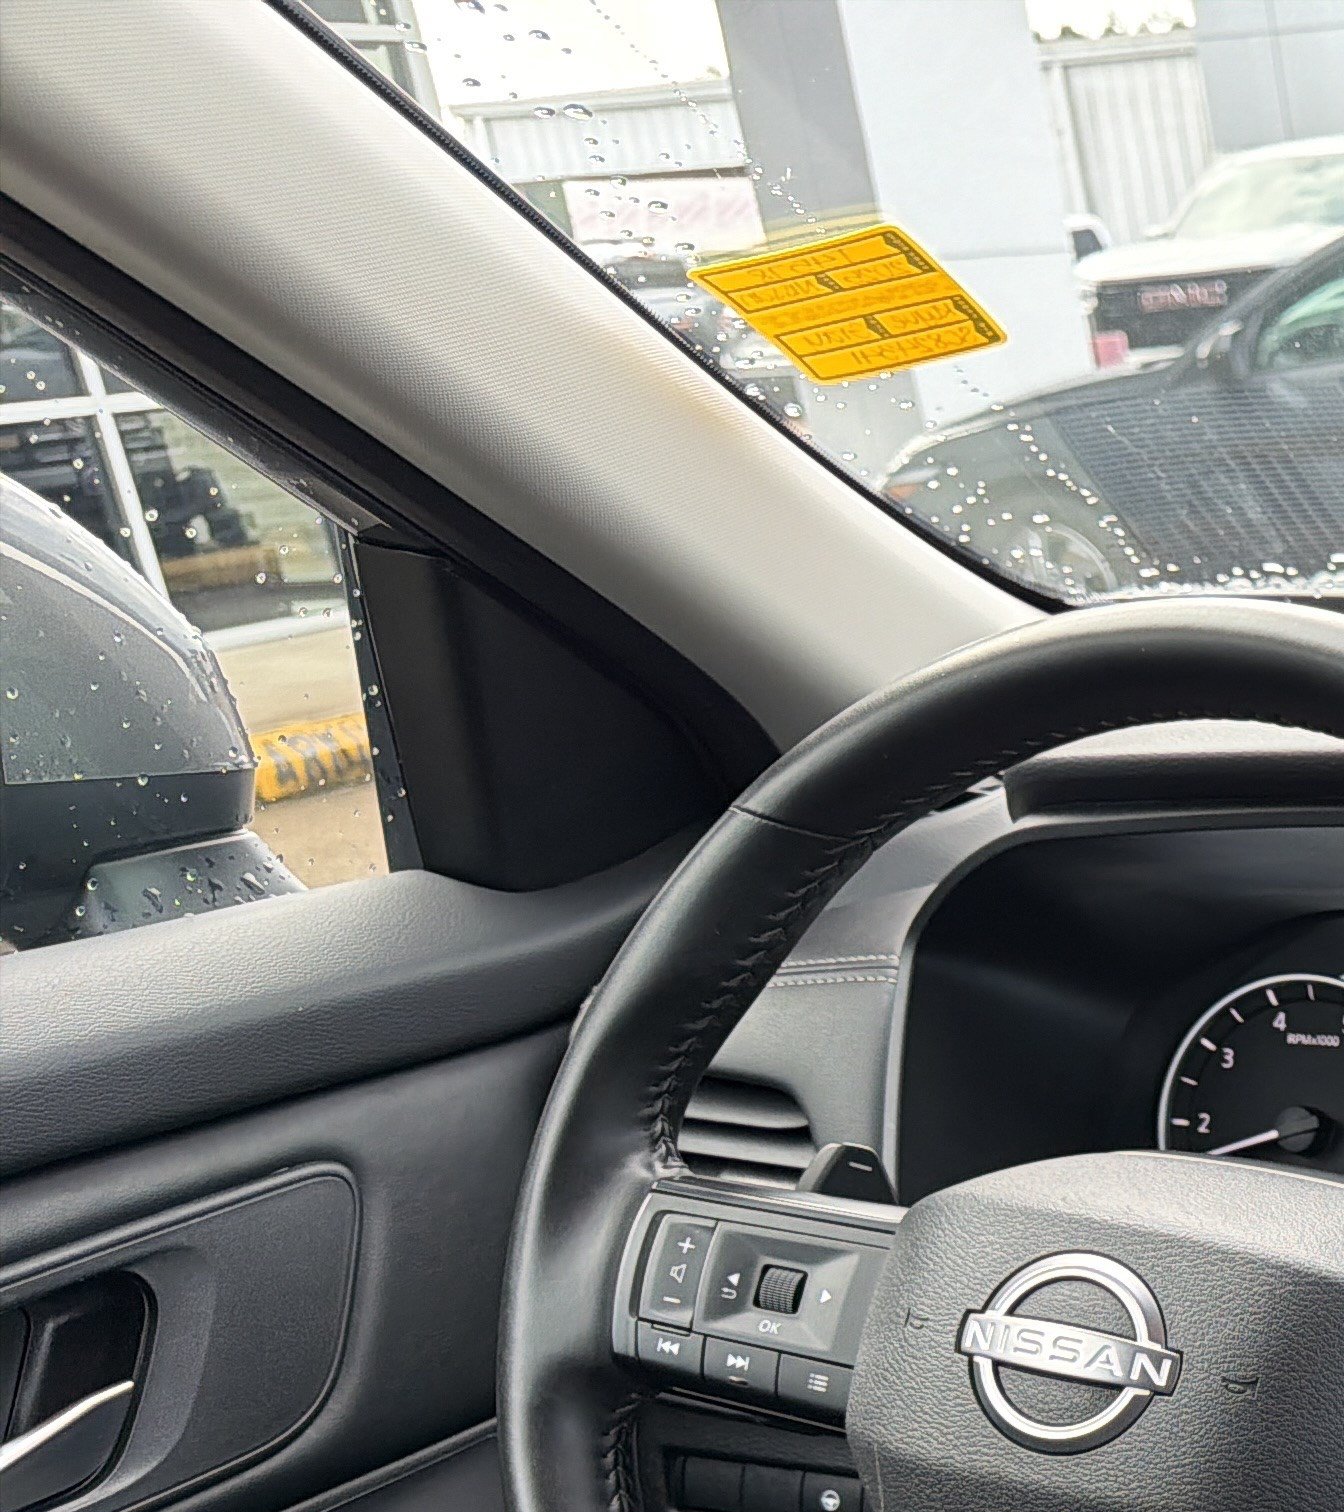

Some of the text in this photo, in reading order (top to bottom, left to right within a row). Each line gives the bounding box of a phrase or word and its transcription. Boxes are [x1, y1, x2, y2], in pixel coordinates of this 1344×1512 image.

[1272, 1011, 1287, 1031] 4
[1220, 1047, 1235, 1069] 3
[1196, 1112, 1211, 1133] 2
[758, 1319, 782, 1335] OK
[964, 1318, 1174, 1388] NISSAN
